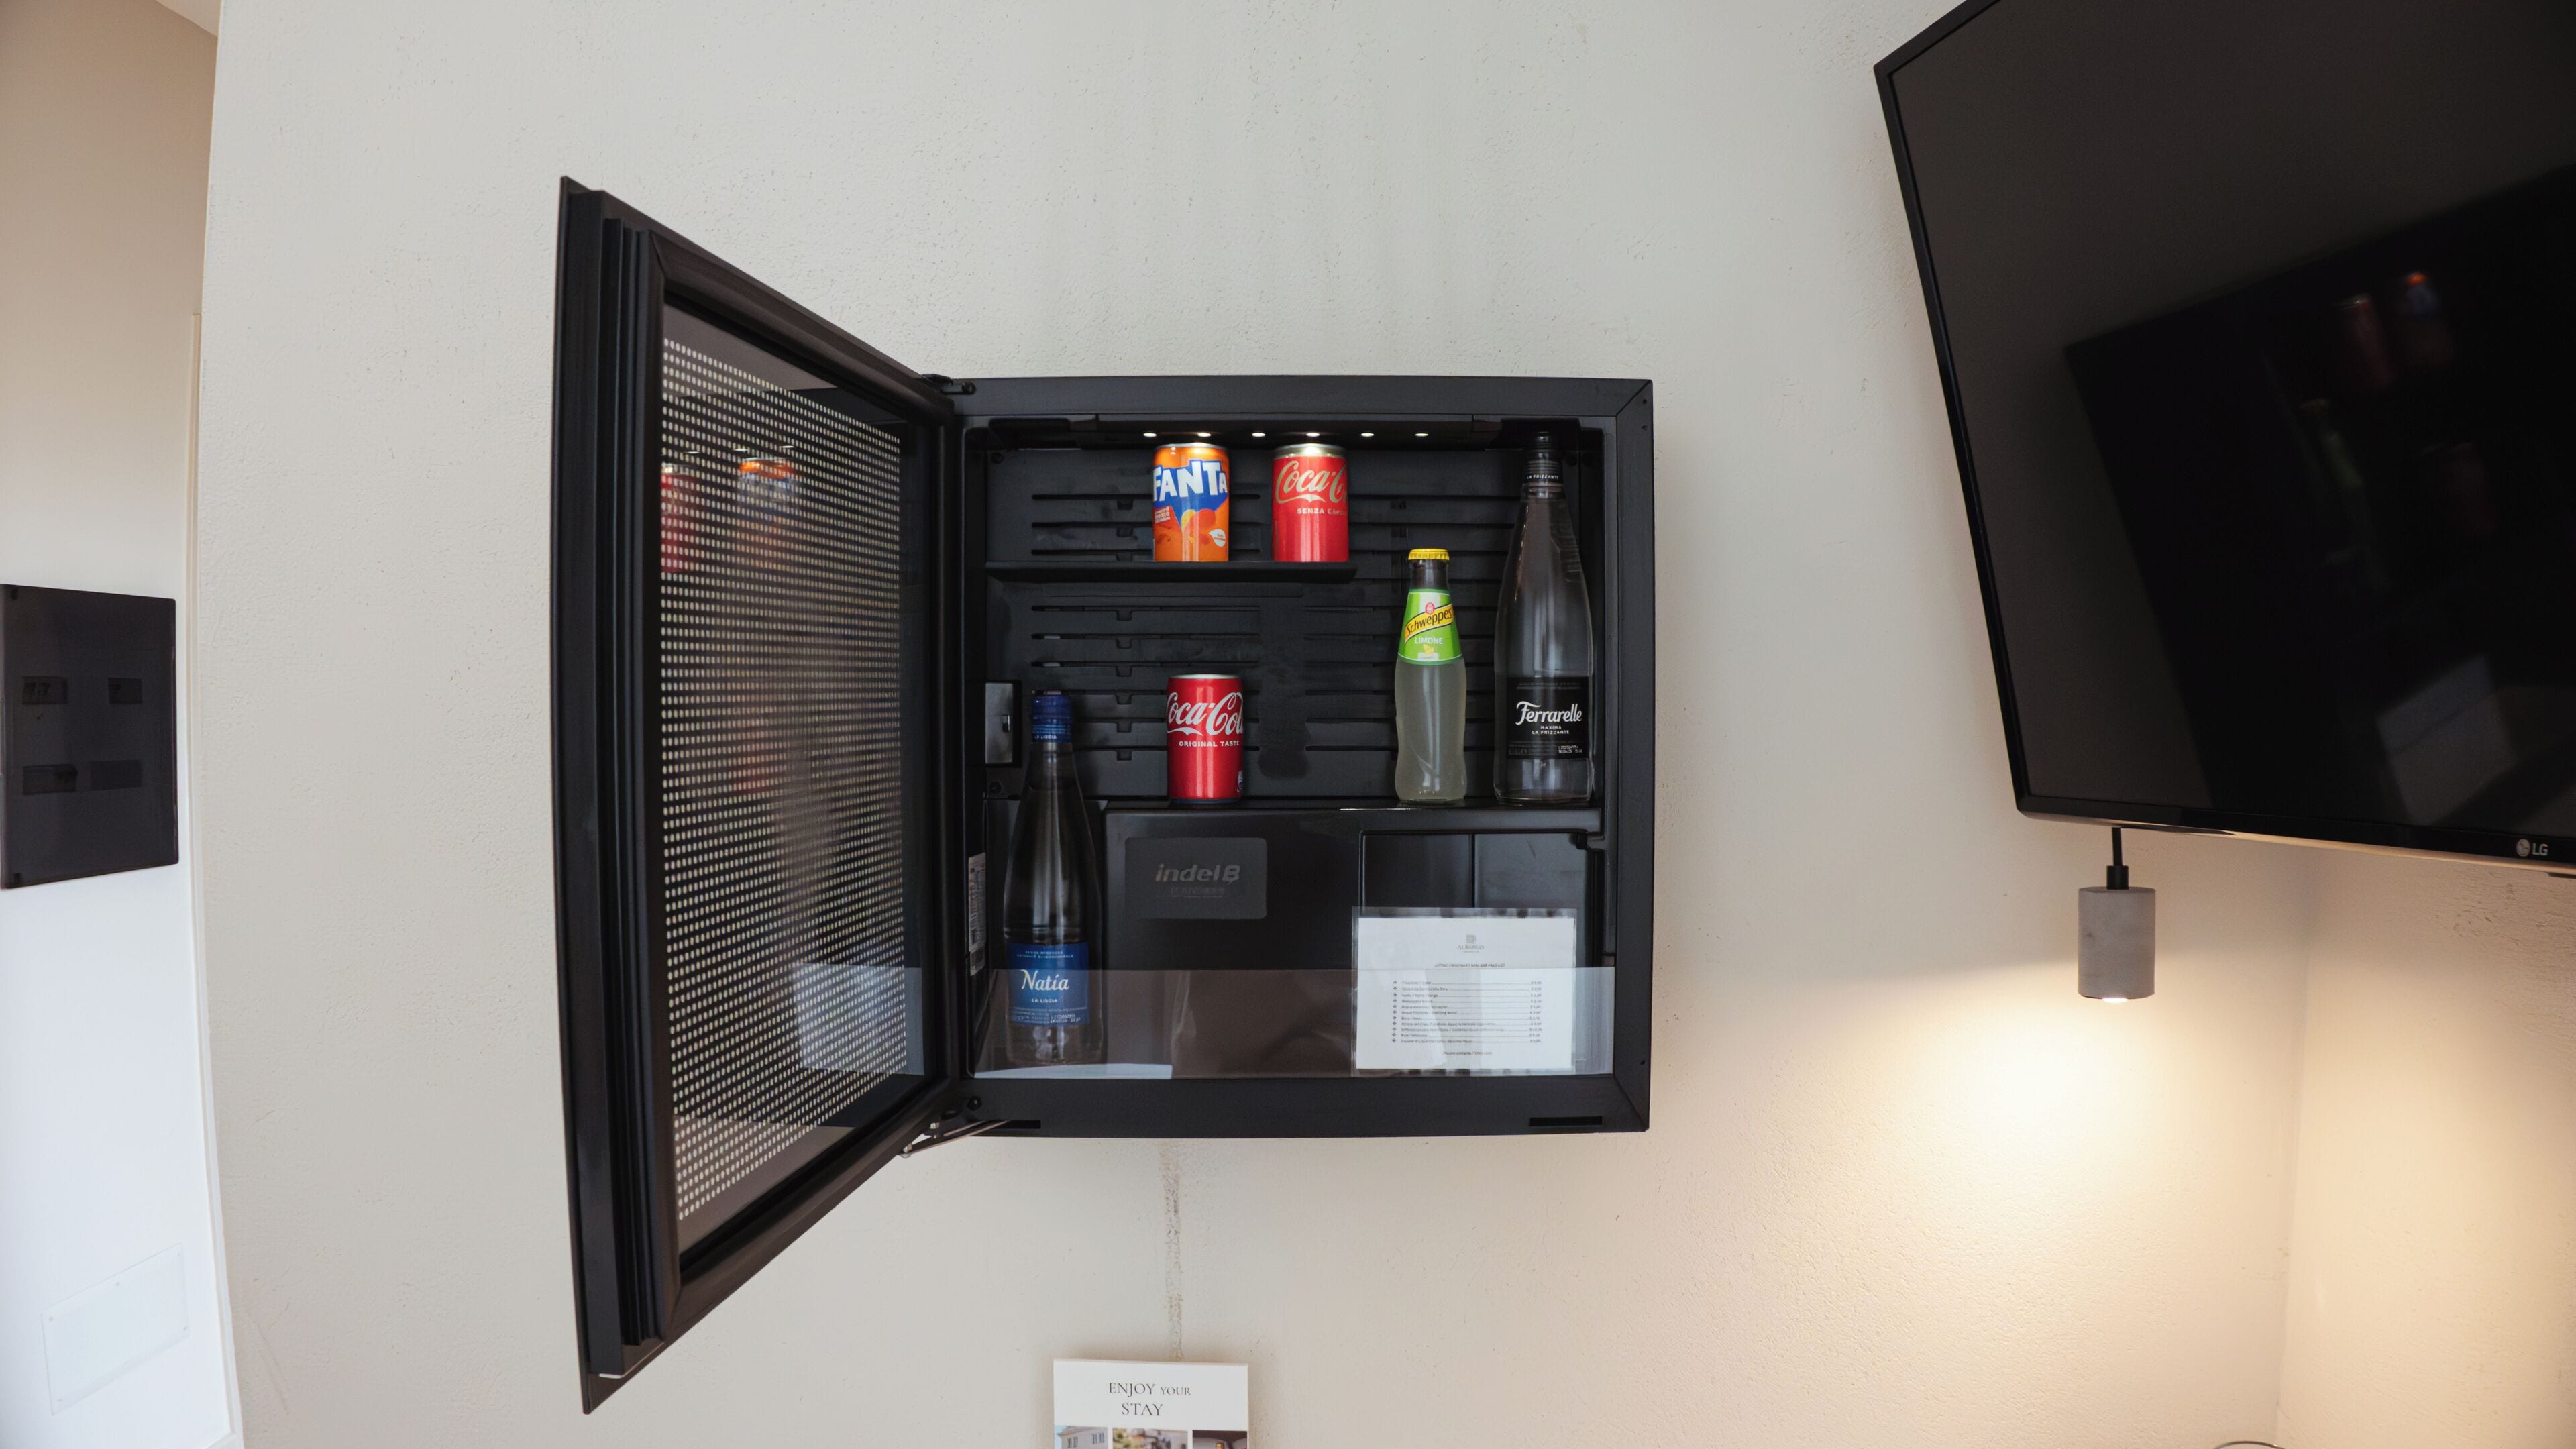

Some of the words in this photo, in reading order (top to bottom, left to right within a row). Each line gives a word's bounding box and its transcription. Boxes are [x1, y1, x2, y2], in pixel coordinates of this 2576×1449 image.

[1153, 460, 1228, 502] FANTA
[1275, 460, 1347, 504] Coca-C
[1407, 608, 1452, 637] Schweppes
[1515, 701, 1582, 725] Ferrarelle
[2532, 843, 2548, 856] LG
[1110, 1383, 1155, 1397] ENJOY
[1160, 1387, 1191, 1395] YOUR
[1122, 1402, 1163, 1415] STAY
